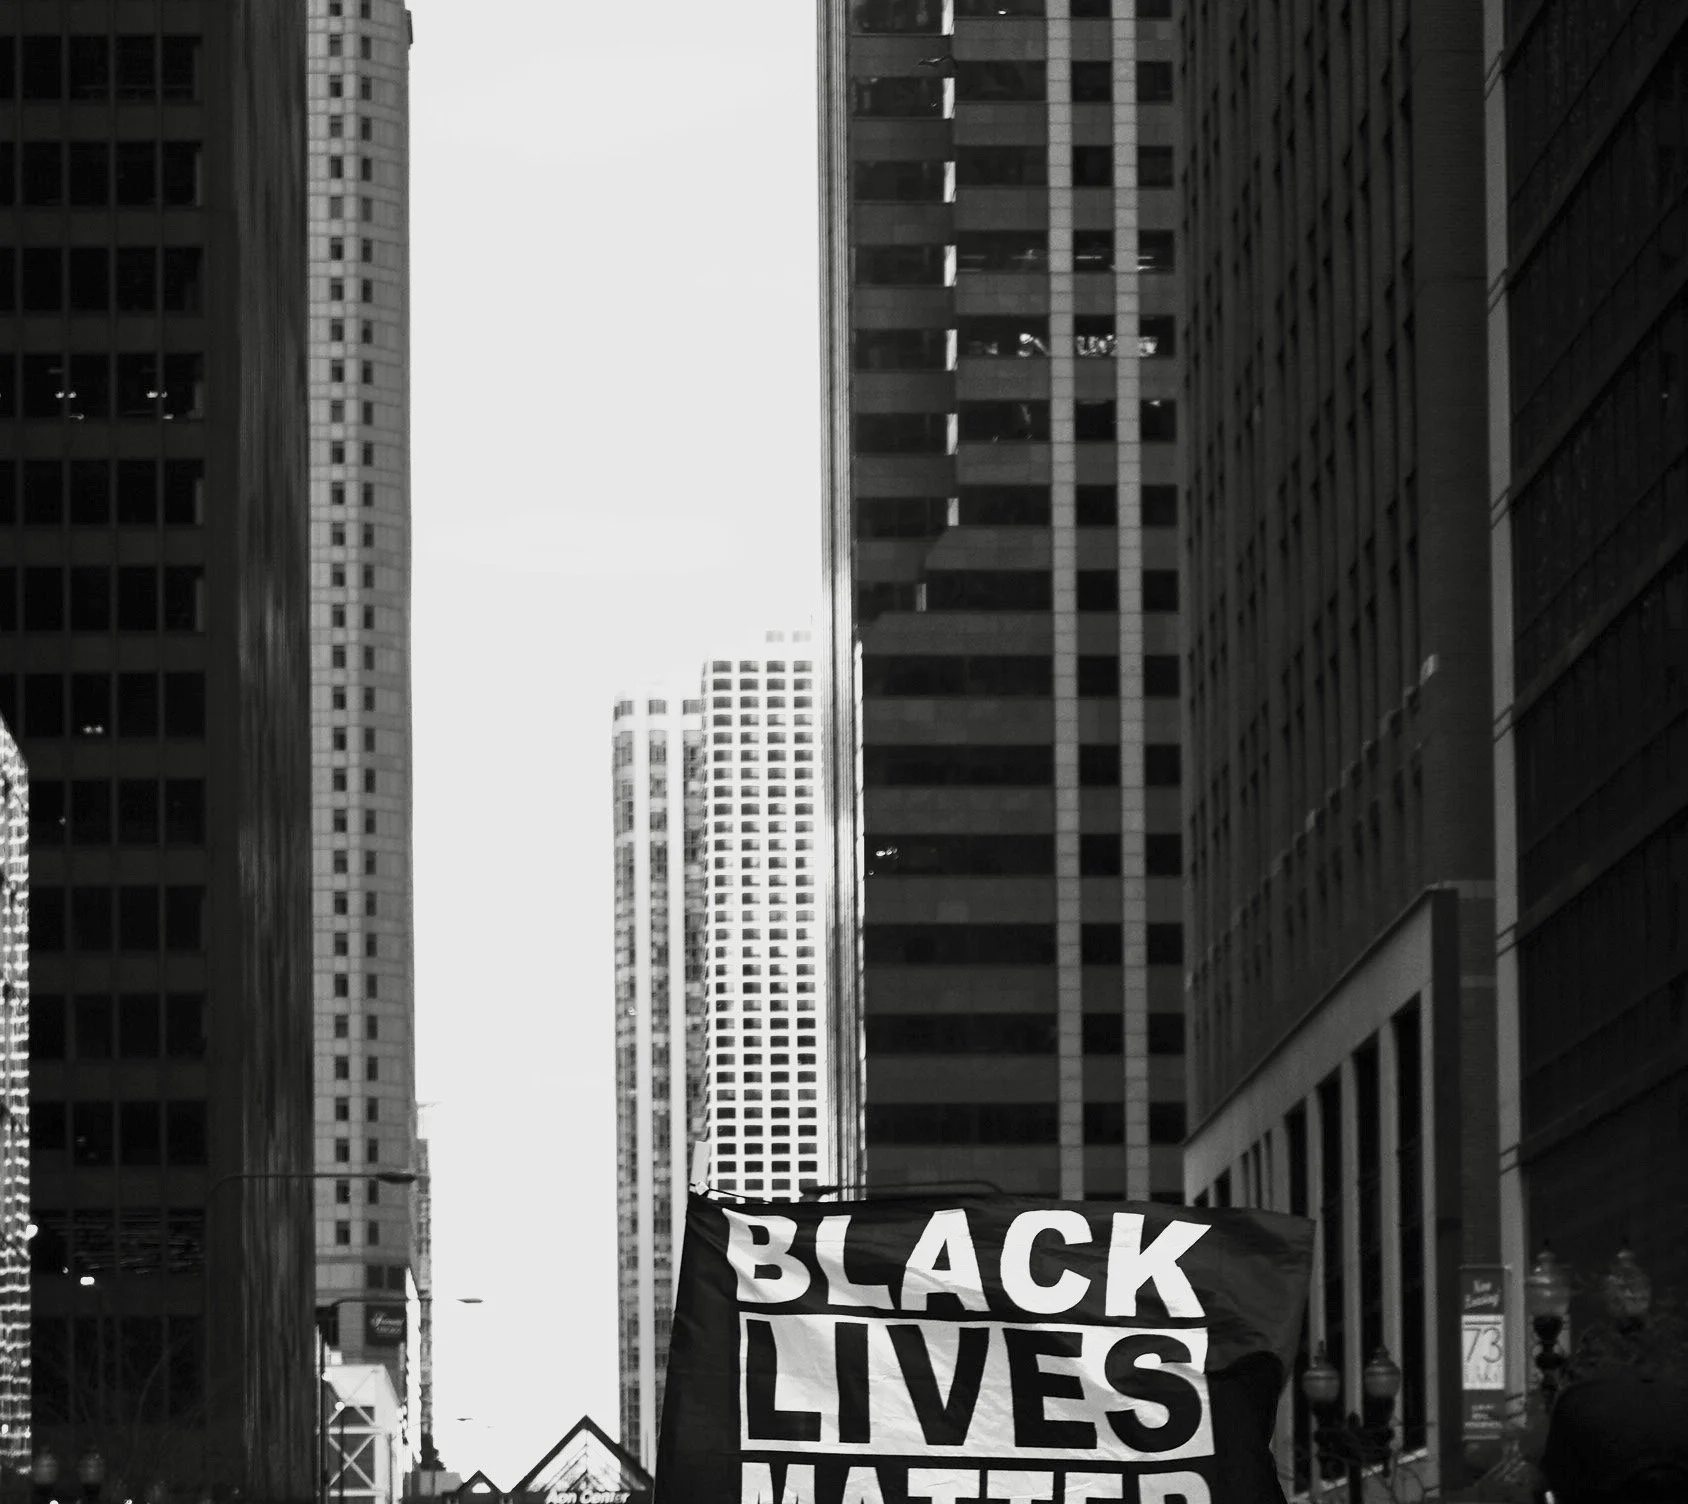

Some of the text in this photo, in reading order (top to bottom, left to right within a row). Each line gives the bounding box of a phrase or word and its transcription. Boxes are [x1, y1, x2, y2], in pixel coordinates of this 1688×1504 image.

[722, 1207, 1211, 1318] BLACK
[1462, 1327, 1501, 1363] 73
[745, 1319, 1203, 1454] LIVES
[545, 1488, 630, 1504] Aon Center
